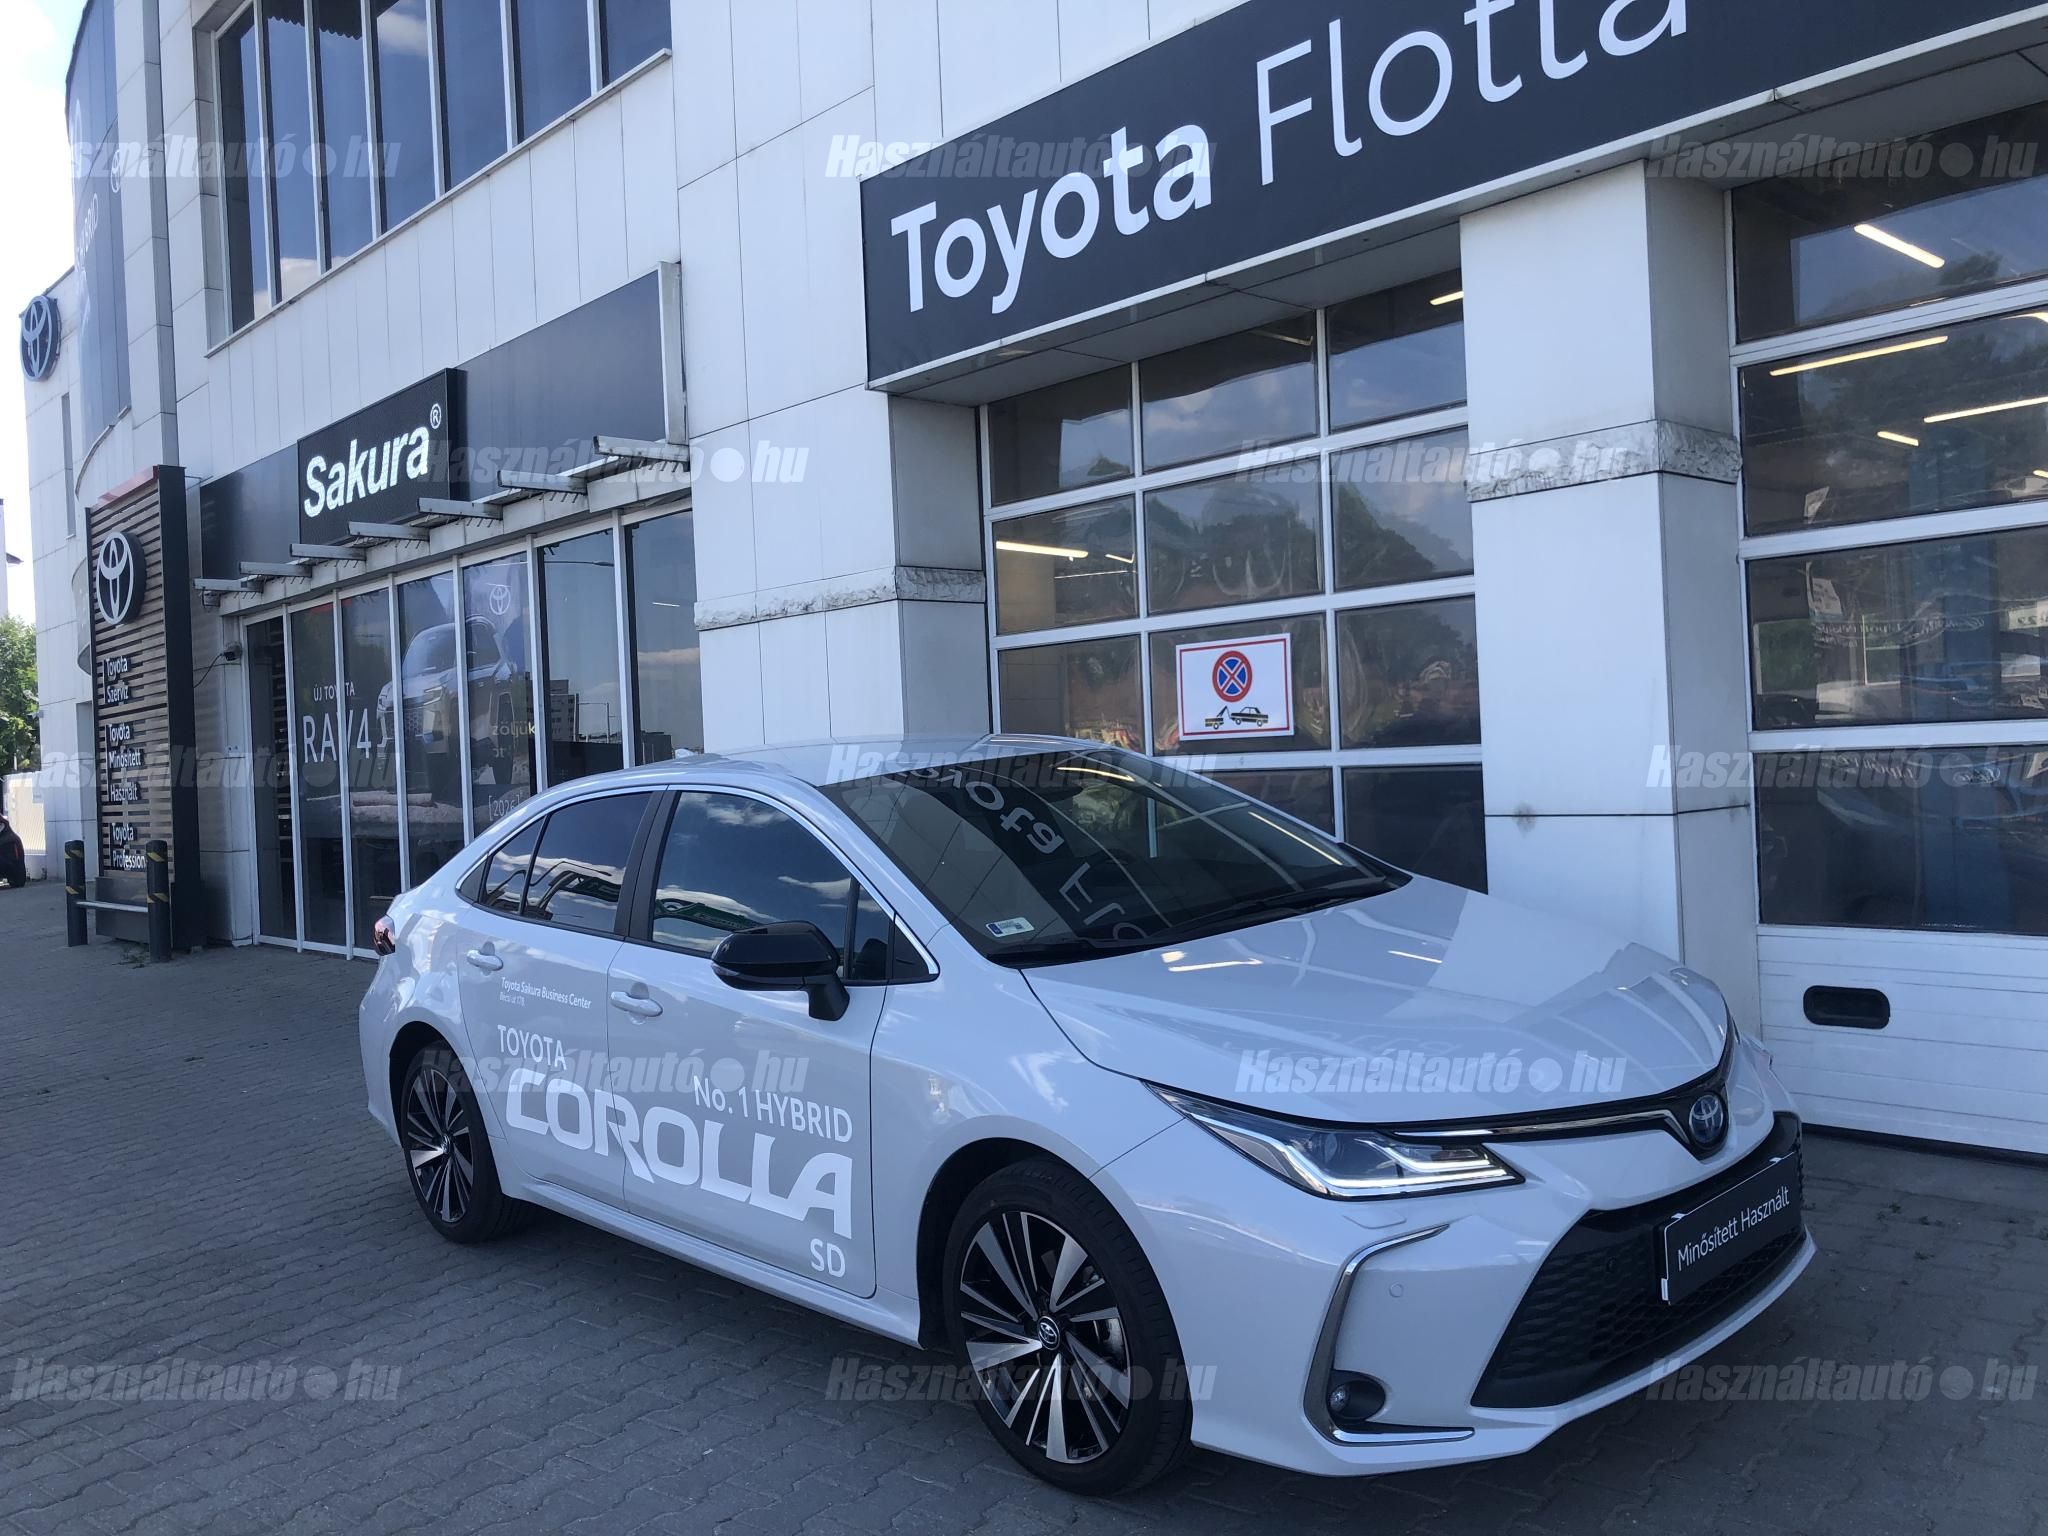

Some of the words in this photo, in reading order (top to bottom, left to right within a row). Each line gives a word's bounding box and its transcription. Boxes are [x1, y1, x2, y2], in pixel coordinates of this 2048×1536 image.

[891, 124, 1212, 314] Toyota
[106, 655, 128, 681] Toyota
[107, 681, 129, 703] Szerviz
[324, 681, 355, 700] TOTA
[109, 723, 131, 746] Toyota
[112, 822, 134, 846] Toyota
[502, 977, 521, 993] Toyota
[521, 982, 541, 997] Sakura
[541, 986, 568, 1004] Business
[569, 993, 592, 1009] Center
[497, 1025, 567, 1071] TOYOTA
[694, 1075, 734, 1114] No.
[738, 1086, 749, 1118] 1
[755, 1089, 853, 1143] HYBRID
[505, 1068, 853, 1239] COROLLA
[1678, 1217, 1739, 1272] Minősített
[1741, 1186, 1790, 1232] Használt
[810, 1238, 846, 1288] SD
